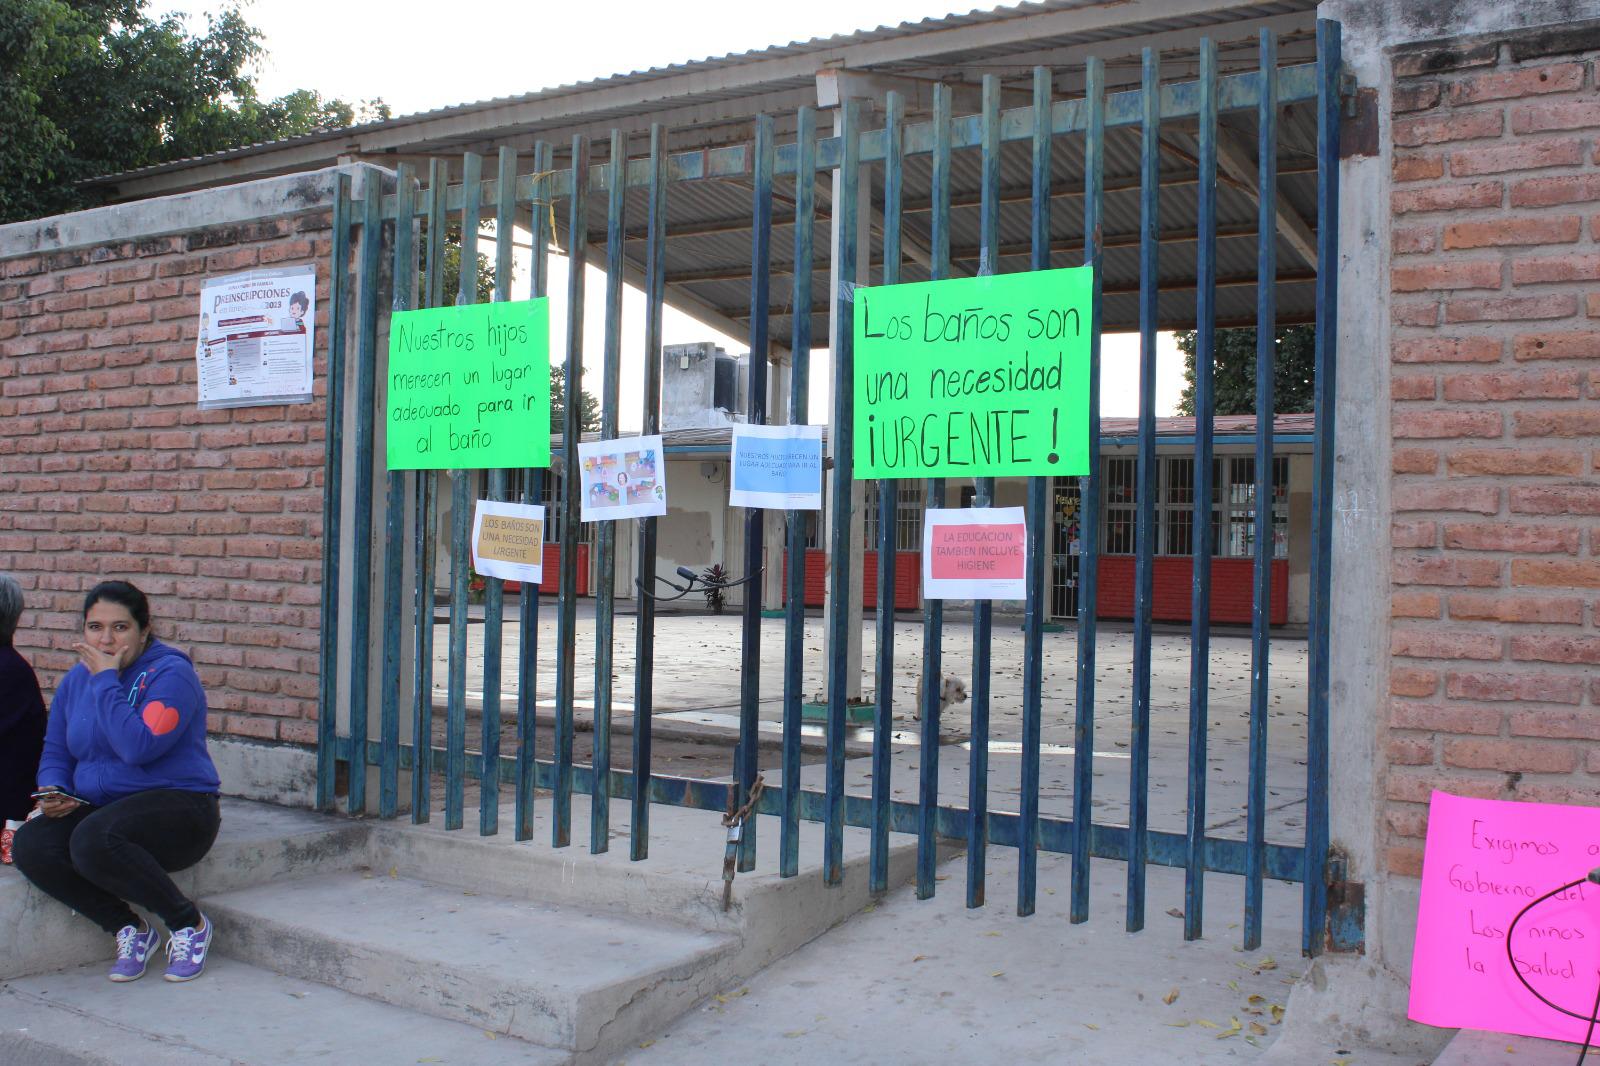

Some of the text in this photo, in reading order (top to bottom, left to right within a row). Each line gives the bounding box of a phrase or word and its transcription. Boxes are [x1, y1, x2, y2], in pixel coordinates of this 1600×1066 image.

[213, 287, 291, 314] PREINSCRIPCIONES
[264, 301, 282, 310] 2023
[863, 293, 1080, 343] Los baños son
[398, 315, 528, 357] Nuestros hijos
[393, 361, 532, 391] merecen un lugar
[866, 350, 1063, 405] una necesidad
[392, 393, 536, 423] adecuado para ir
[416, 422, 492, 454] al baño
[482, 531, 539, 547] UNA NECESIDAD
[484, 519, 540, 533] LOS BAÑOS SON
[943, 531, 955, 543] LA
[493, 546, 528, 560] URGENTE
[936, 546, 1020, 556] TAMBIEN INCLUYE
[957, 560, 996, 571] HIGIENE
[1471, 819, 1560, 864] Exigimos
[1449, 863, 1536, 898] Gobierno
[1470, 909, 1505, 938] Los
[1466, 947, 1485, 974] la
